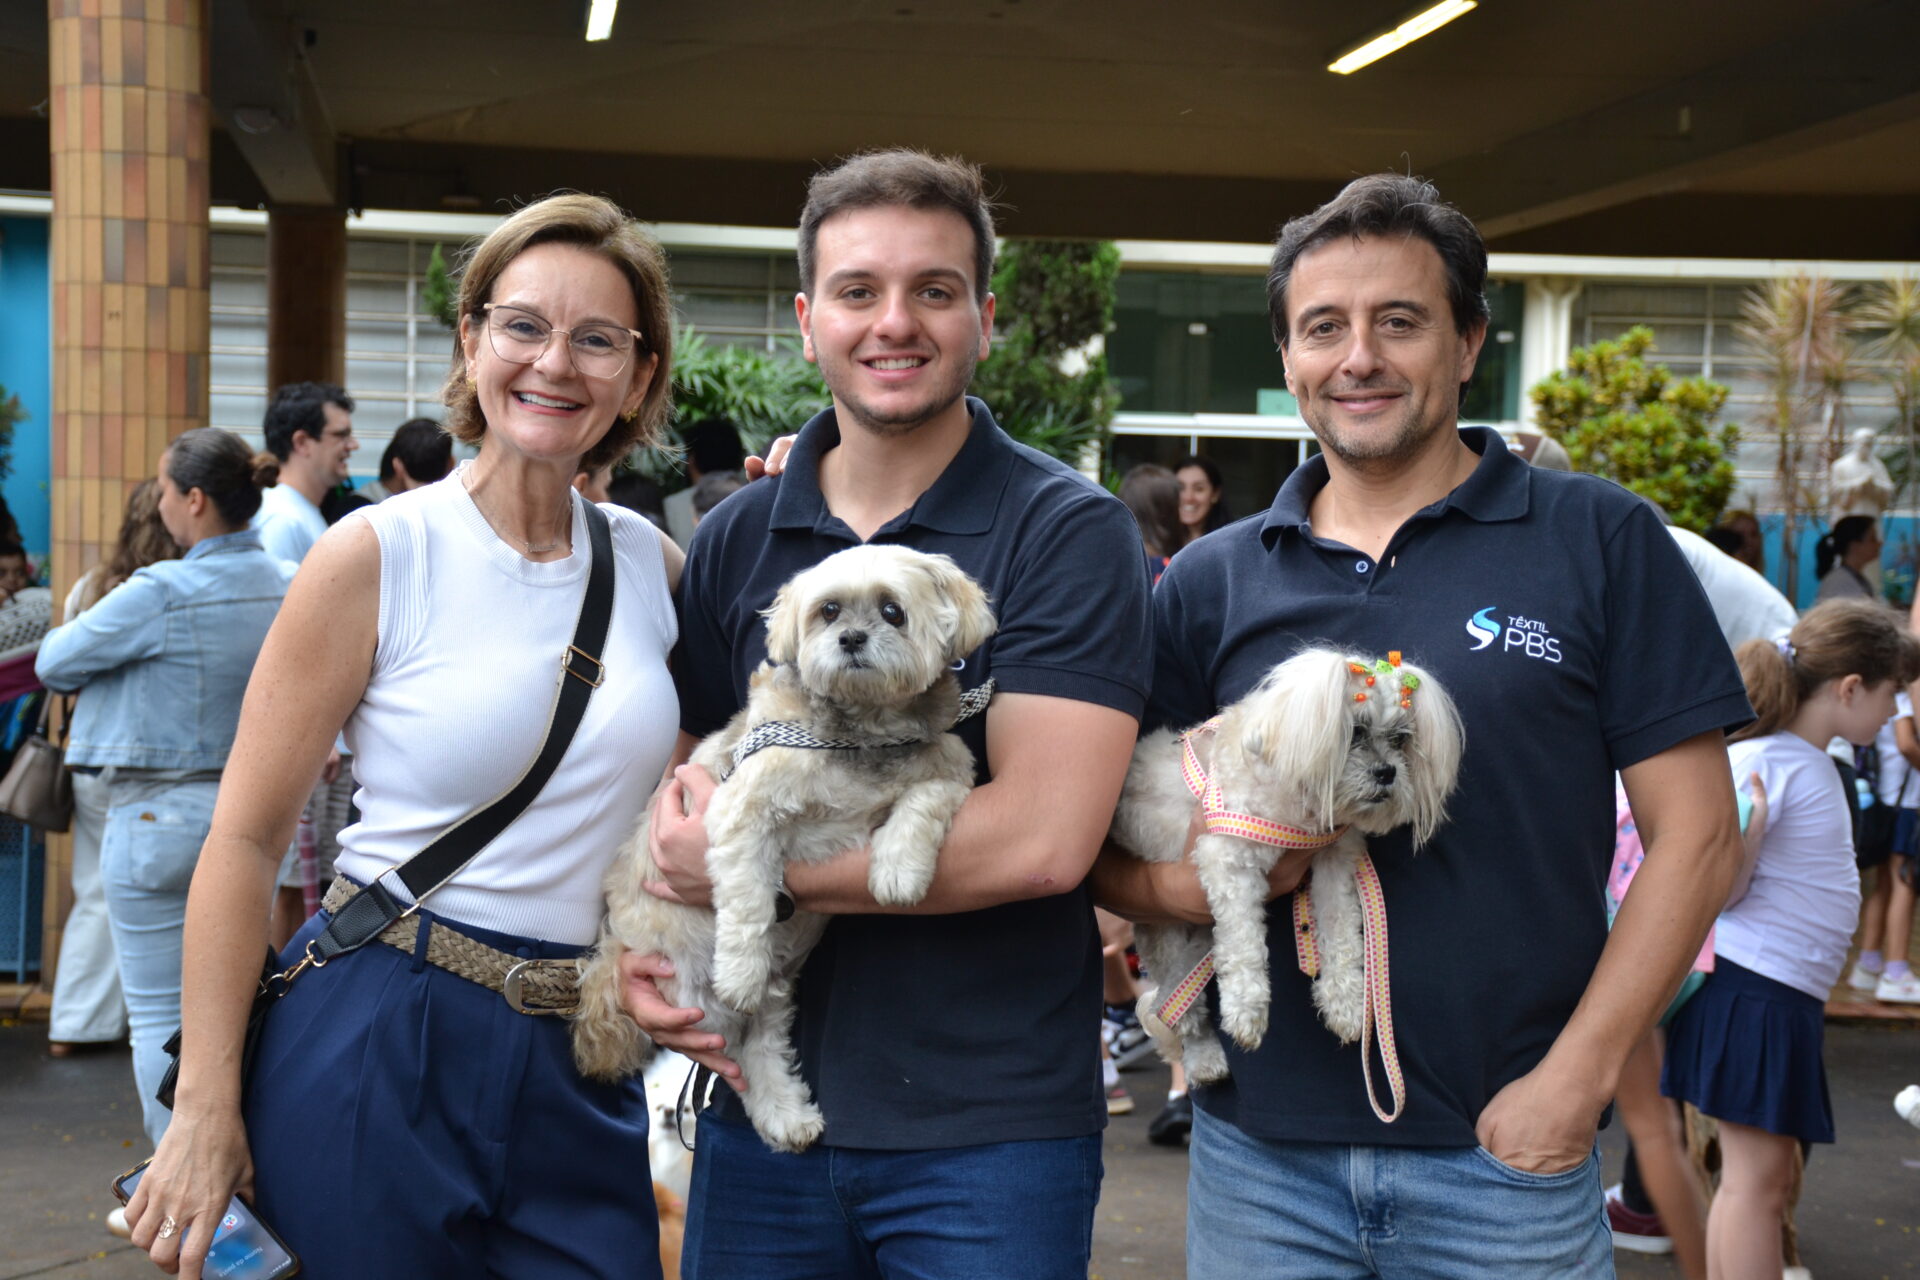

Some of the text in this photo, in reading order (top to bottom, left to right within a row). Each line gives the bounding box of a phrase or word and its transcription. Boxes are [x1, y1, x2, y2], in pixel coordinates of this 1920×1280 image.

[1508, 616, 1550, 633] TÊXTIL
[1504, 627, 1562, 663] PBS
[244, 1246, 263, 1260] Nome
